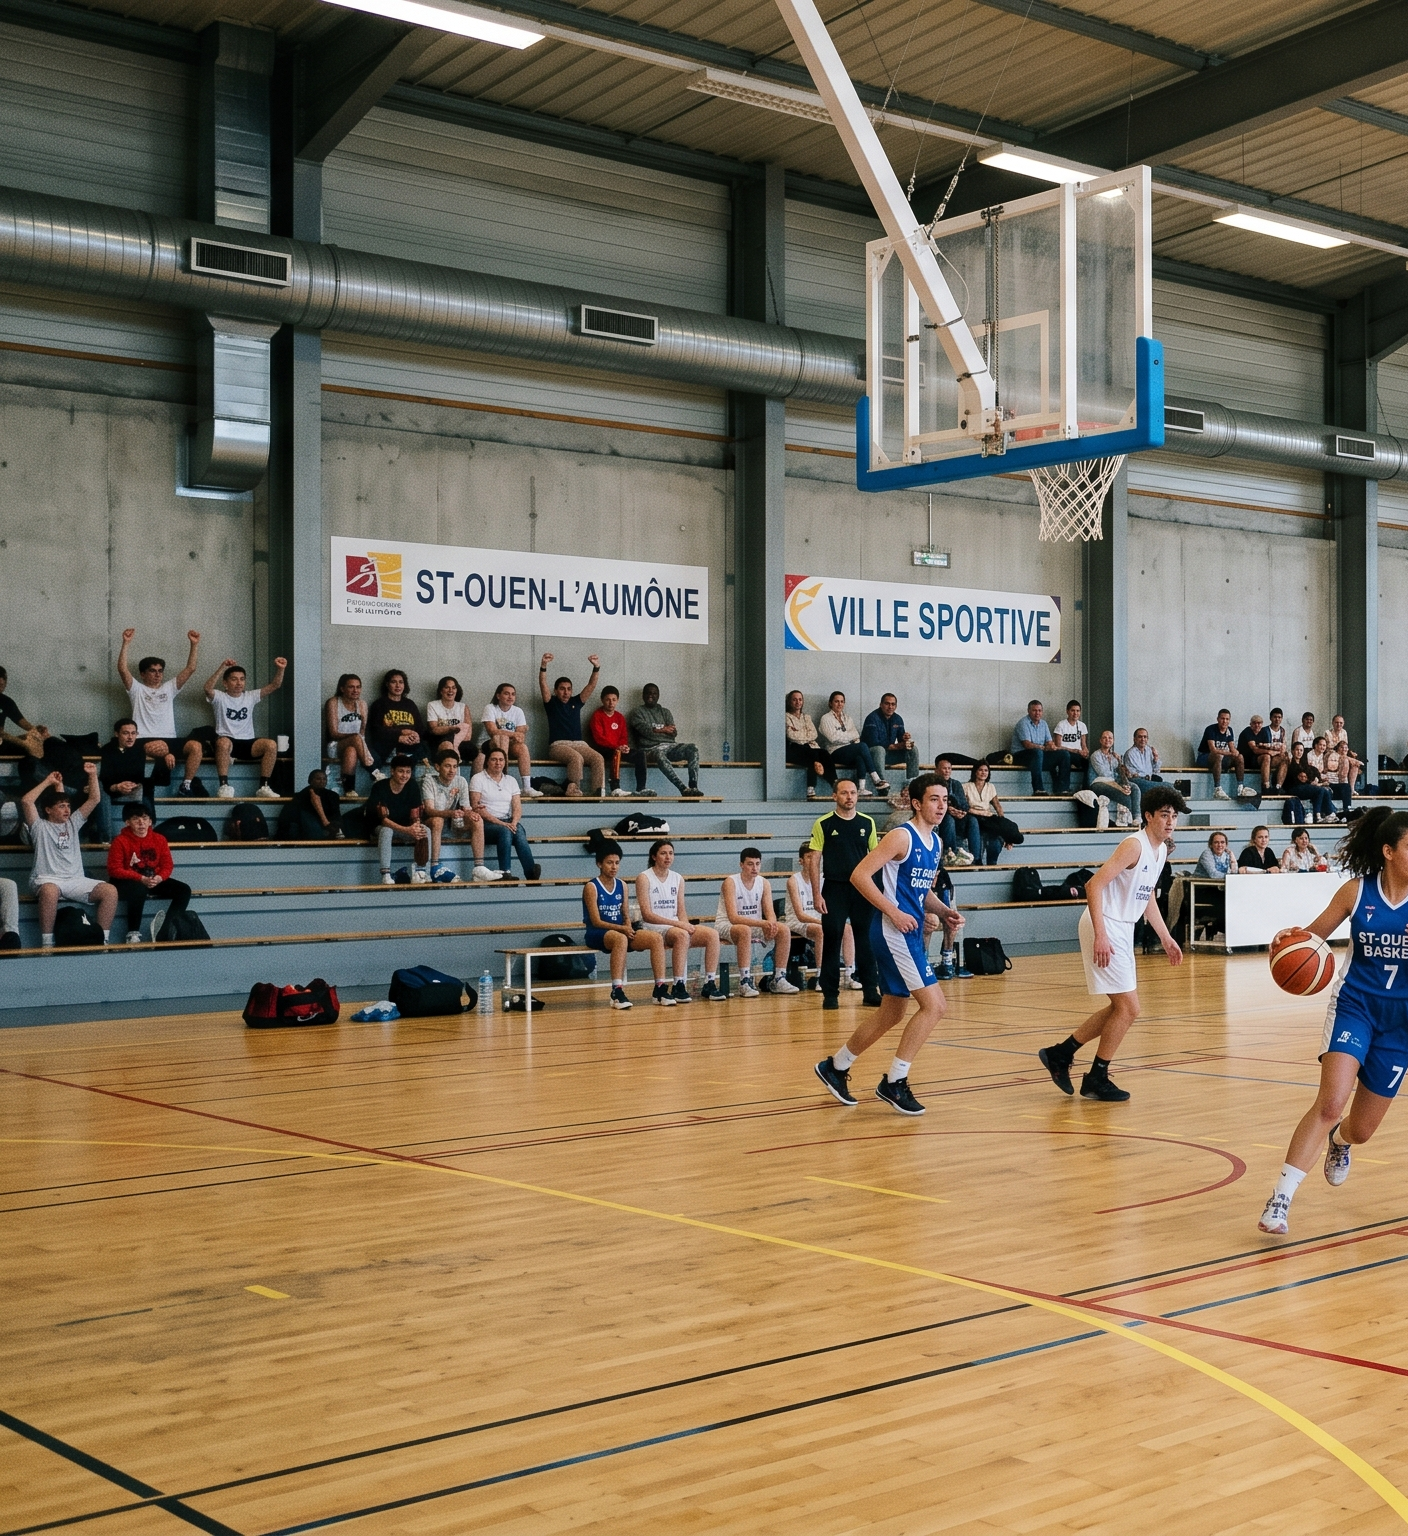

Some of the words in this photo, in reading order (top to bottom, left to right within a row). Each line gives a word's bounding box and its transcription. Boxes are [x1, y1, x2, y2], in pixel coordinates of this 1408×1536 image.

[416, 569, 699, 620] ST-OUEN-L'AUMÔNE
[828, 595, 909, 639] VILLE
[918, 601, 1051, 647] SPORTIVE
[1383, 964, 1399, 990] 7
[1387, 1065, 1404, 1089] 7
